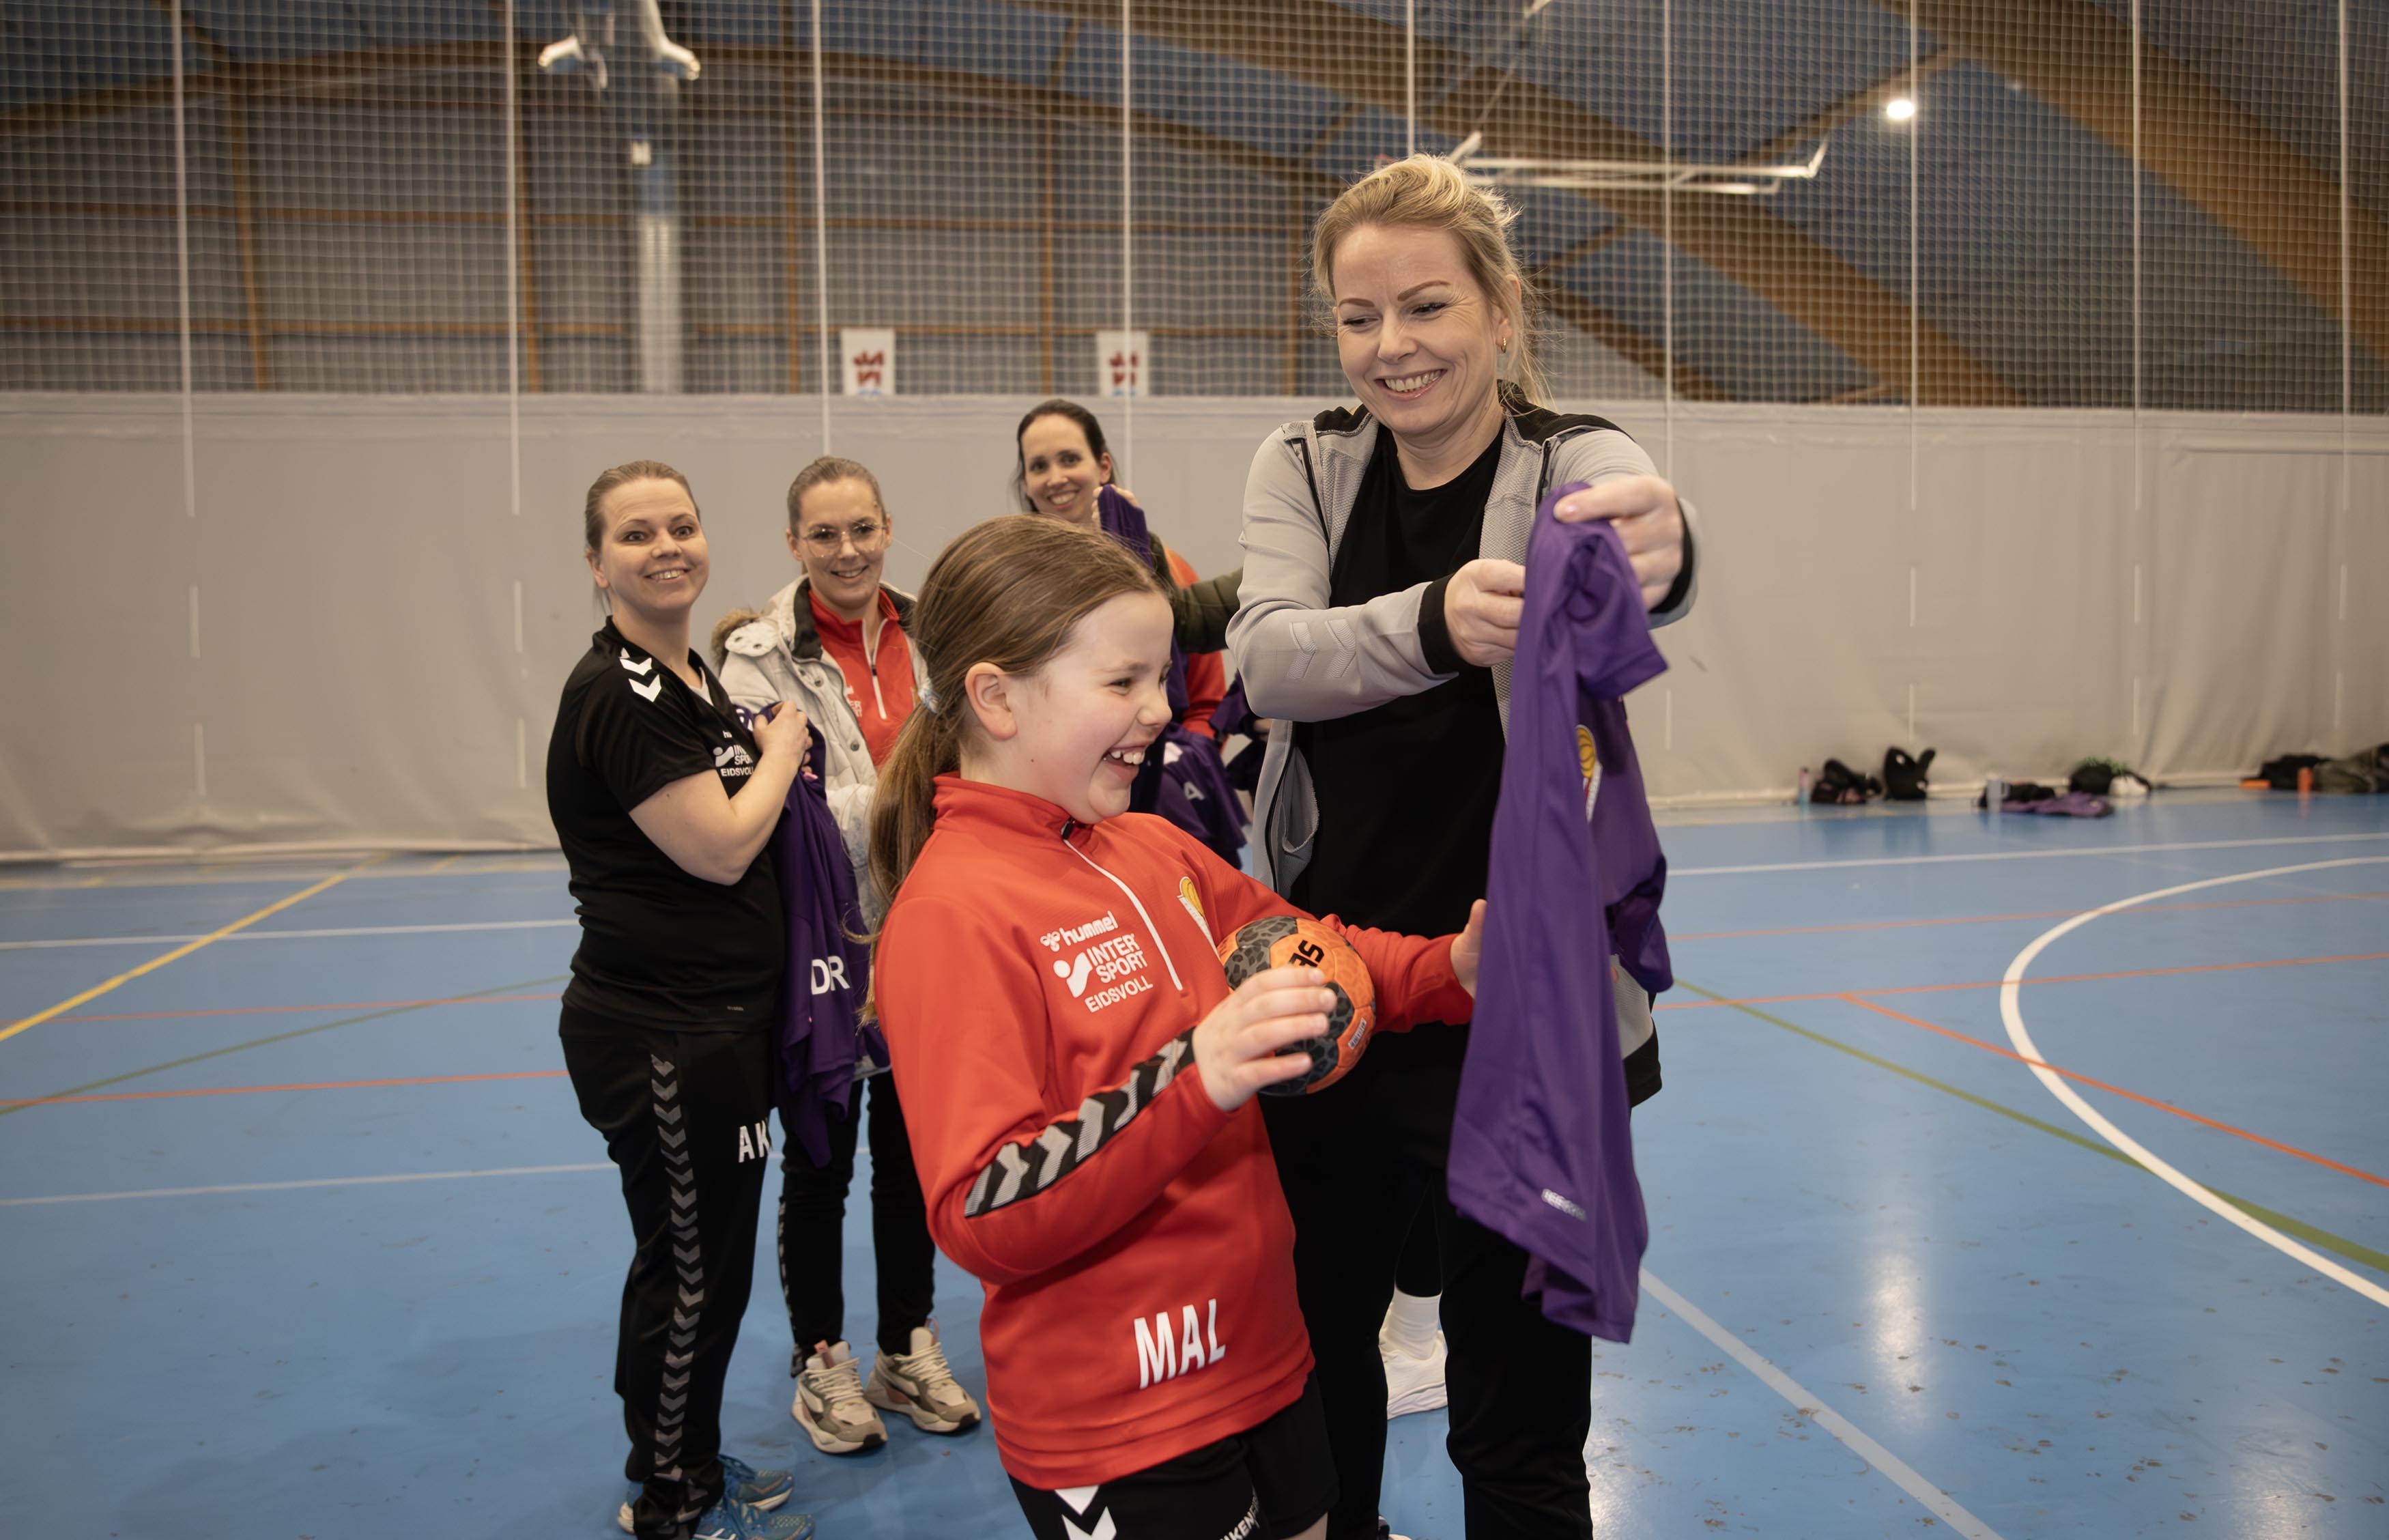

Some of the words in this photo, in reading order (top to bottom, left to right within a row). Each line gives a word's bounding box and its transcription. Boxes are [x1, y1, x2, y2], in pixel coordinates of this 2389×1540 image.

[1059, 910, 1118, 945] hummel
[1086, 934, 1140, 967] INTER
[1096, 950, 1147, 984] SPORT
[1085, 975, 1153, 1012] EIDSVOLL
[1134, 1298, 1226, 1389] MAL
